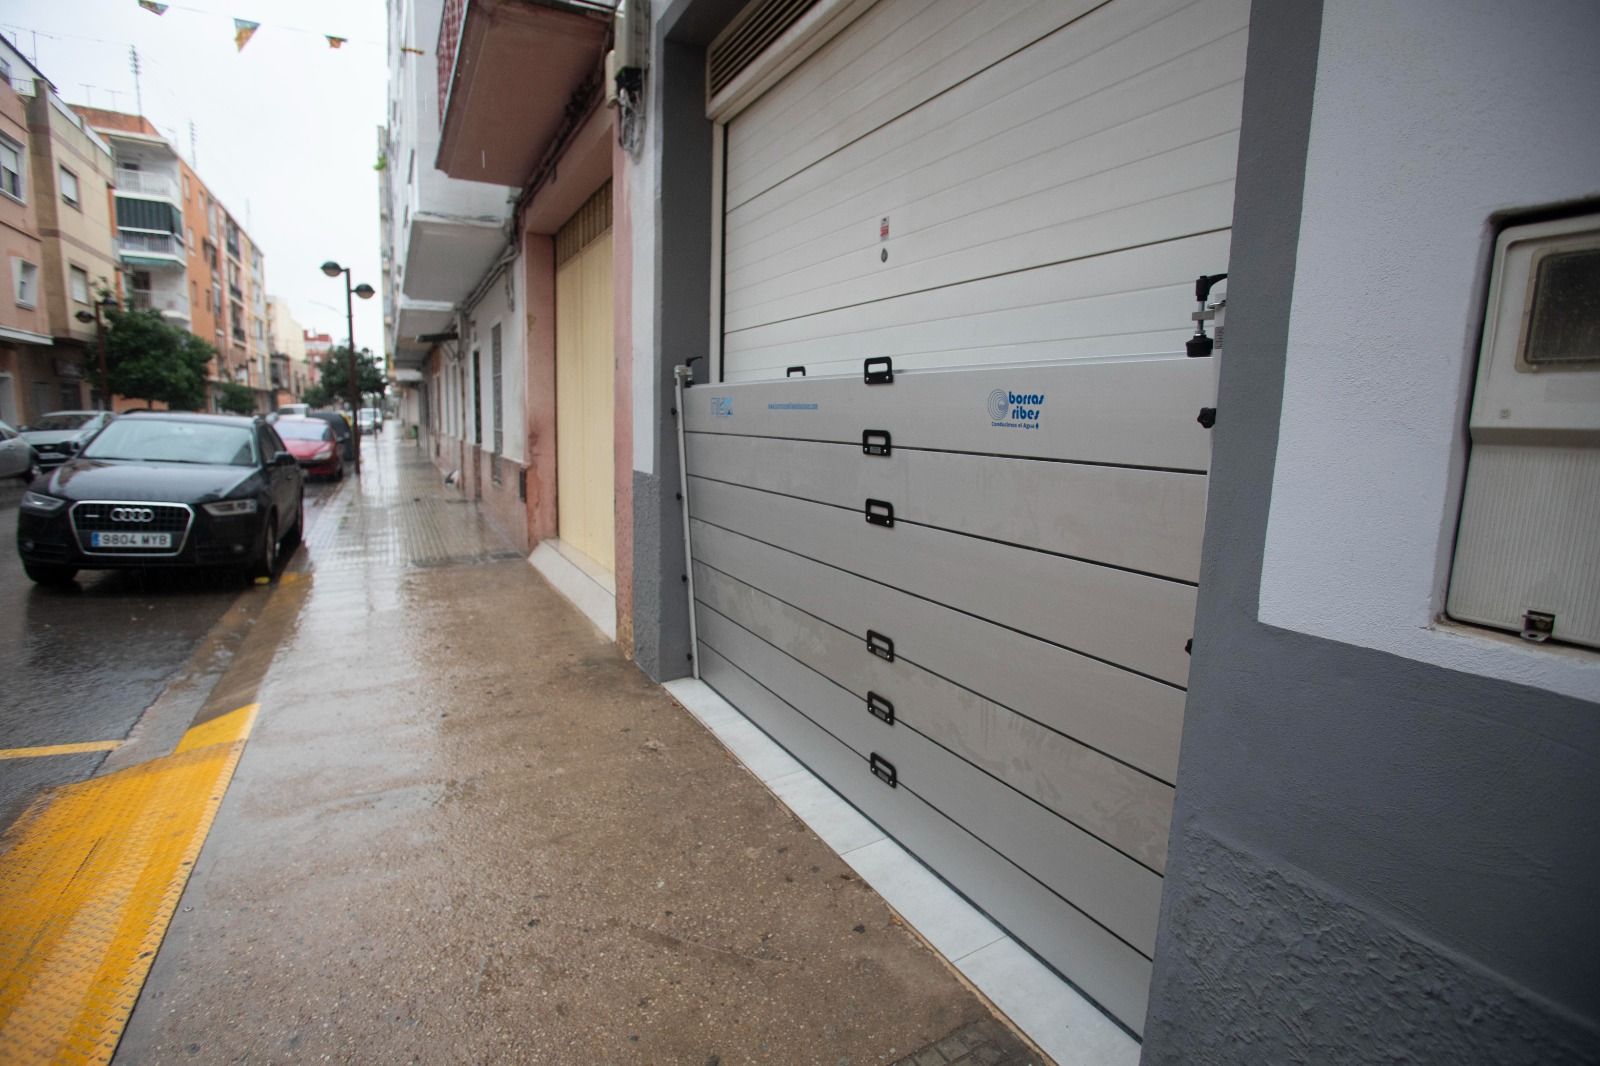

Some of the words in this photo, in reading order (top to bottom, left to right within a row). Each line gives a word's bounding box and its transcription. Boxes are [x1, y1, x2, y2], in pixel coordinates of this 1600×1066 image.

[1008, 391, 1045, 405] borras
[1011, 405, 1040, 420] ribes
[102, 534, 137, 545] 9804
[141, 534, 168, 545] MYB
